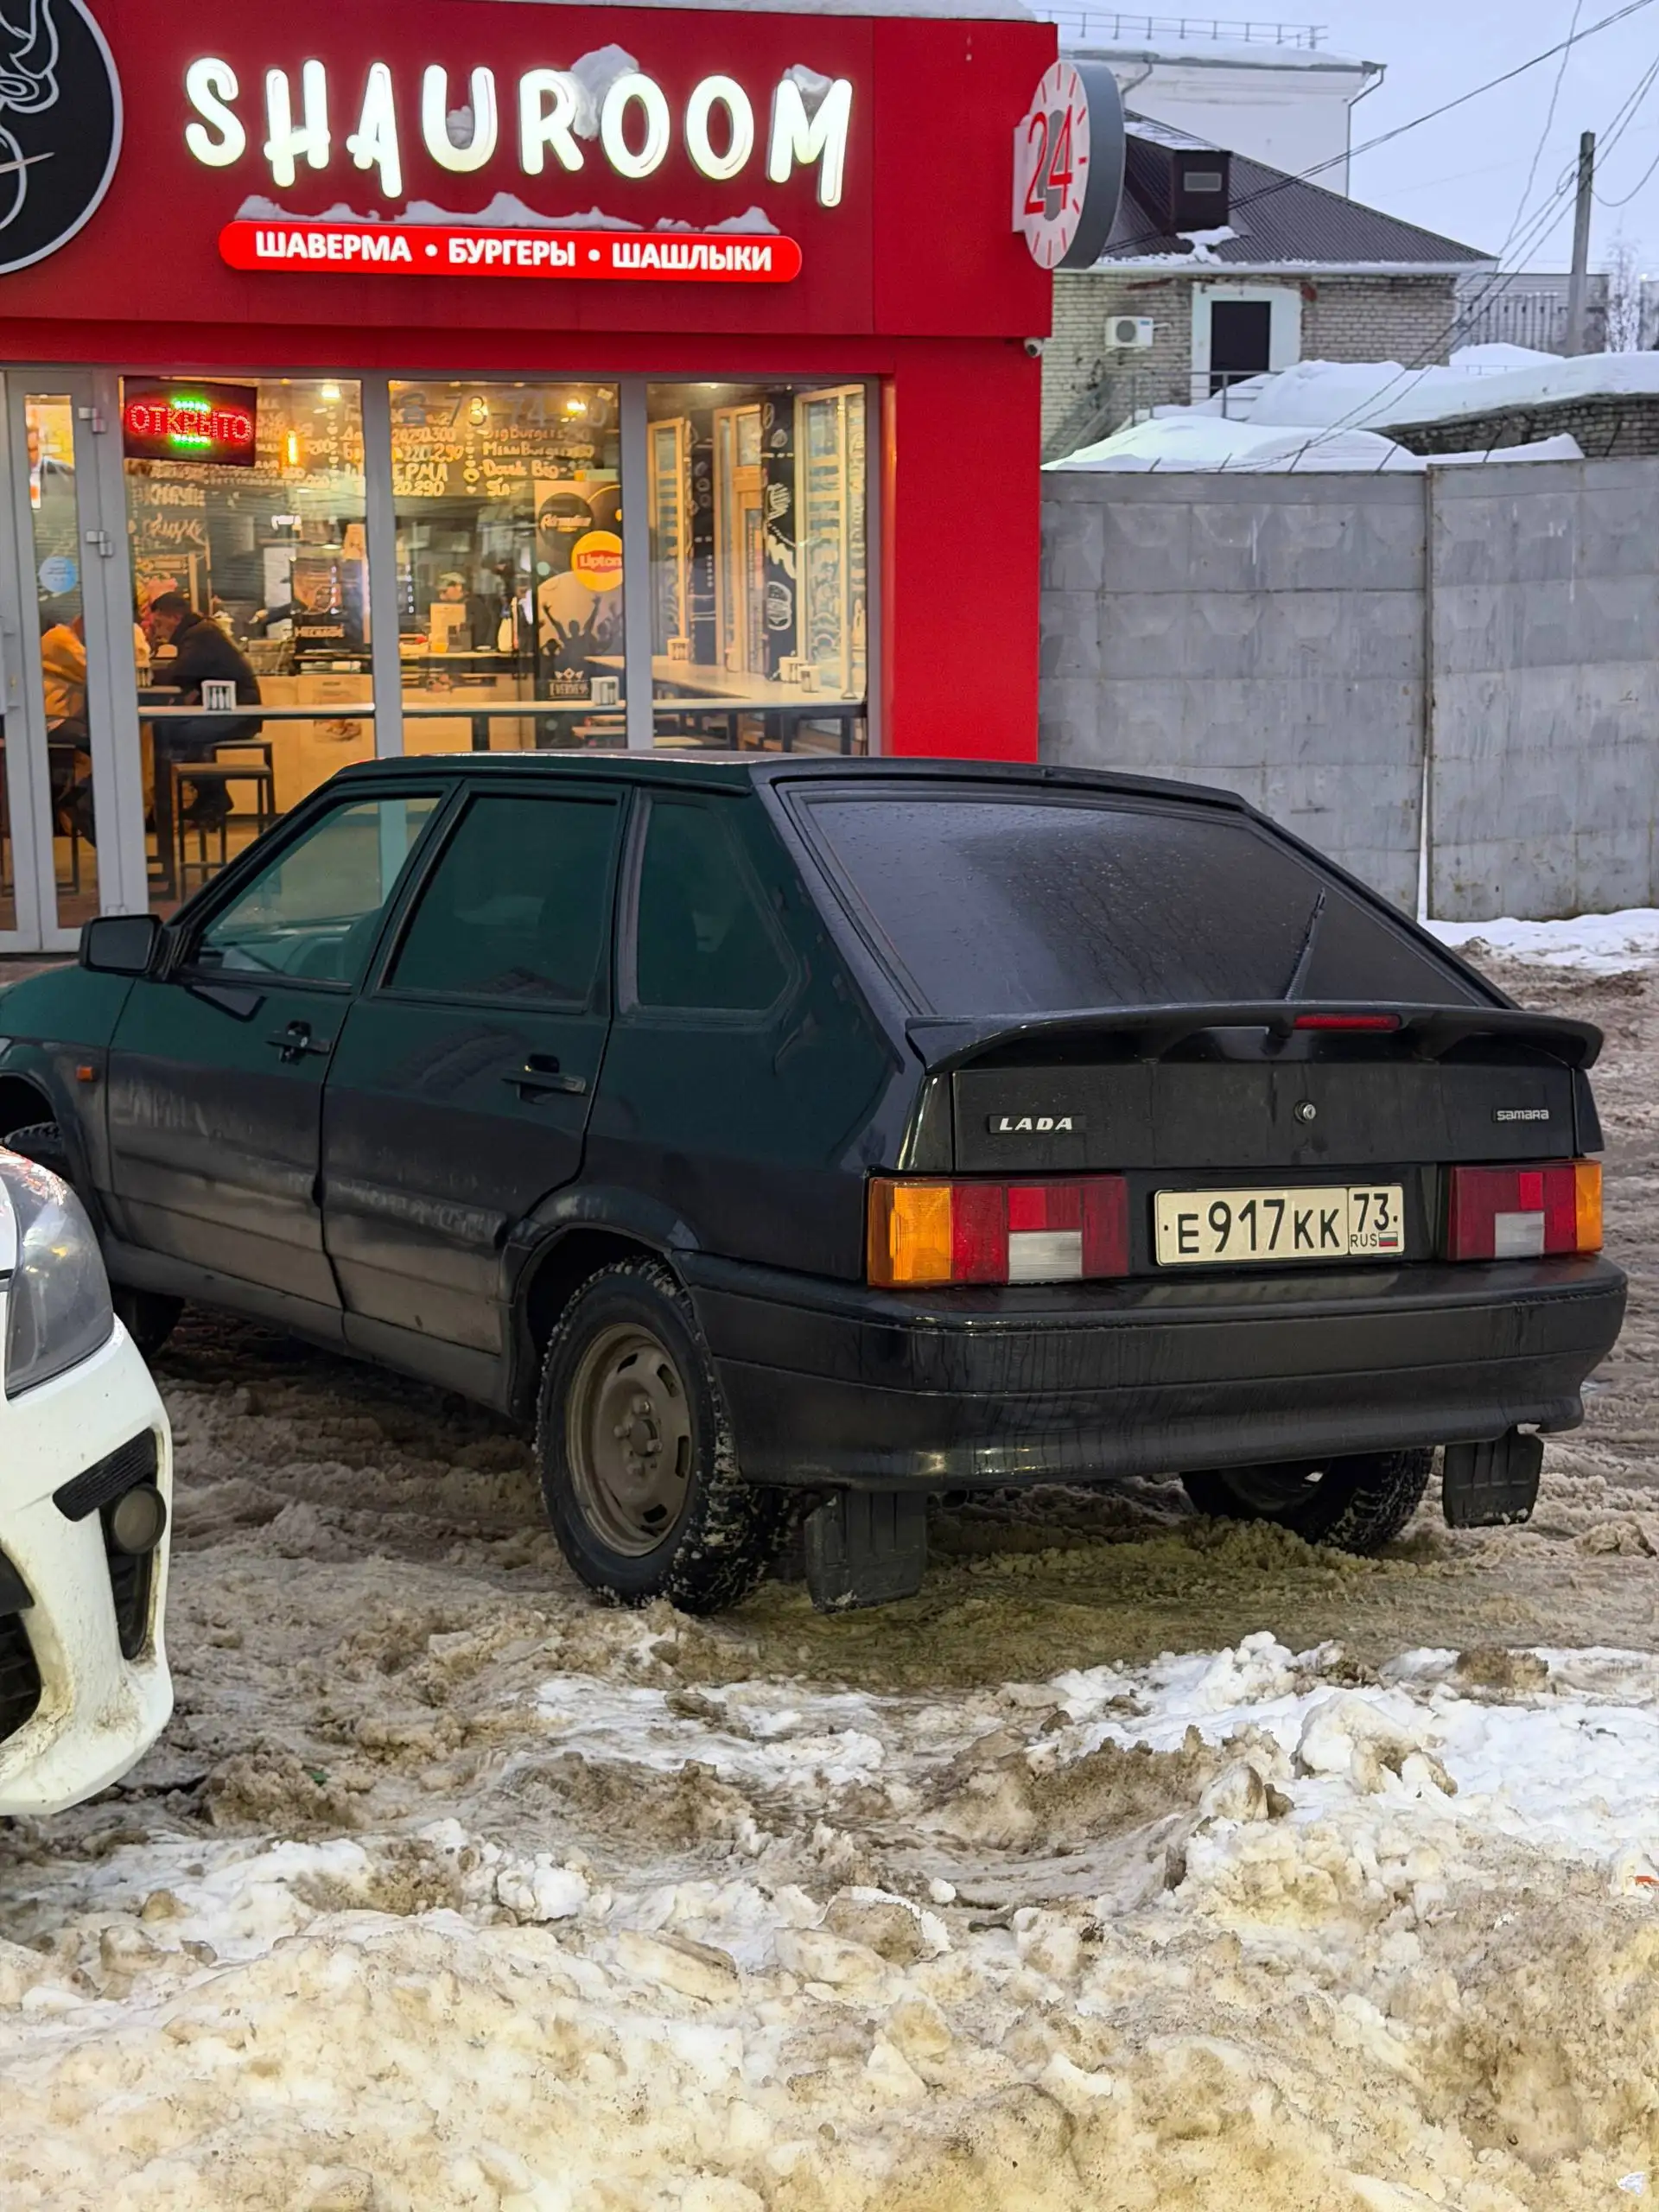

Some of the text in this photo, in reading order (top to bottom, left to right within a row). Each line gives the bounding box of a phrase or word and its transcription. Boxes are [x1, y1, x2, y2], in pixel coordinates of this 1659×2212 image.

[184, 56, 853, 207] SHAUROOM
[1024, 103, 1073, 214] 24
[255, 230, 772, 272] ШАВЕРМА БУРГЕРЫ ШАШЛЫКИ
[130, 404, 253, 442] ОТКРЫТО
[999, 1117, 1073, 1131] LADA
[1177, 1192, 1389, 1255] Е917КК 73
[1350, 1233, 1377, 1248] RUS
